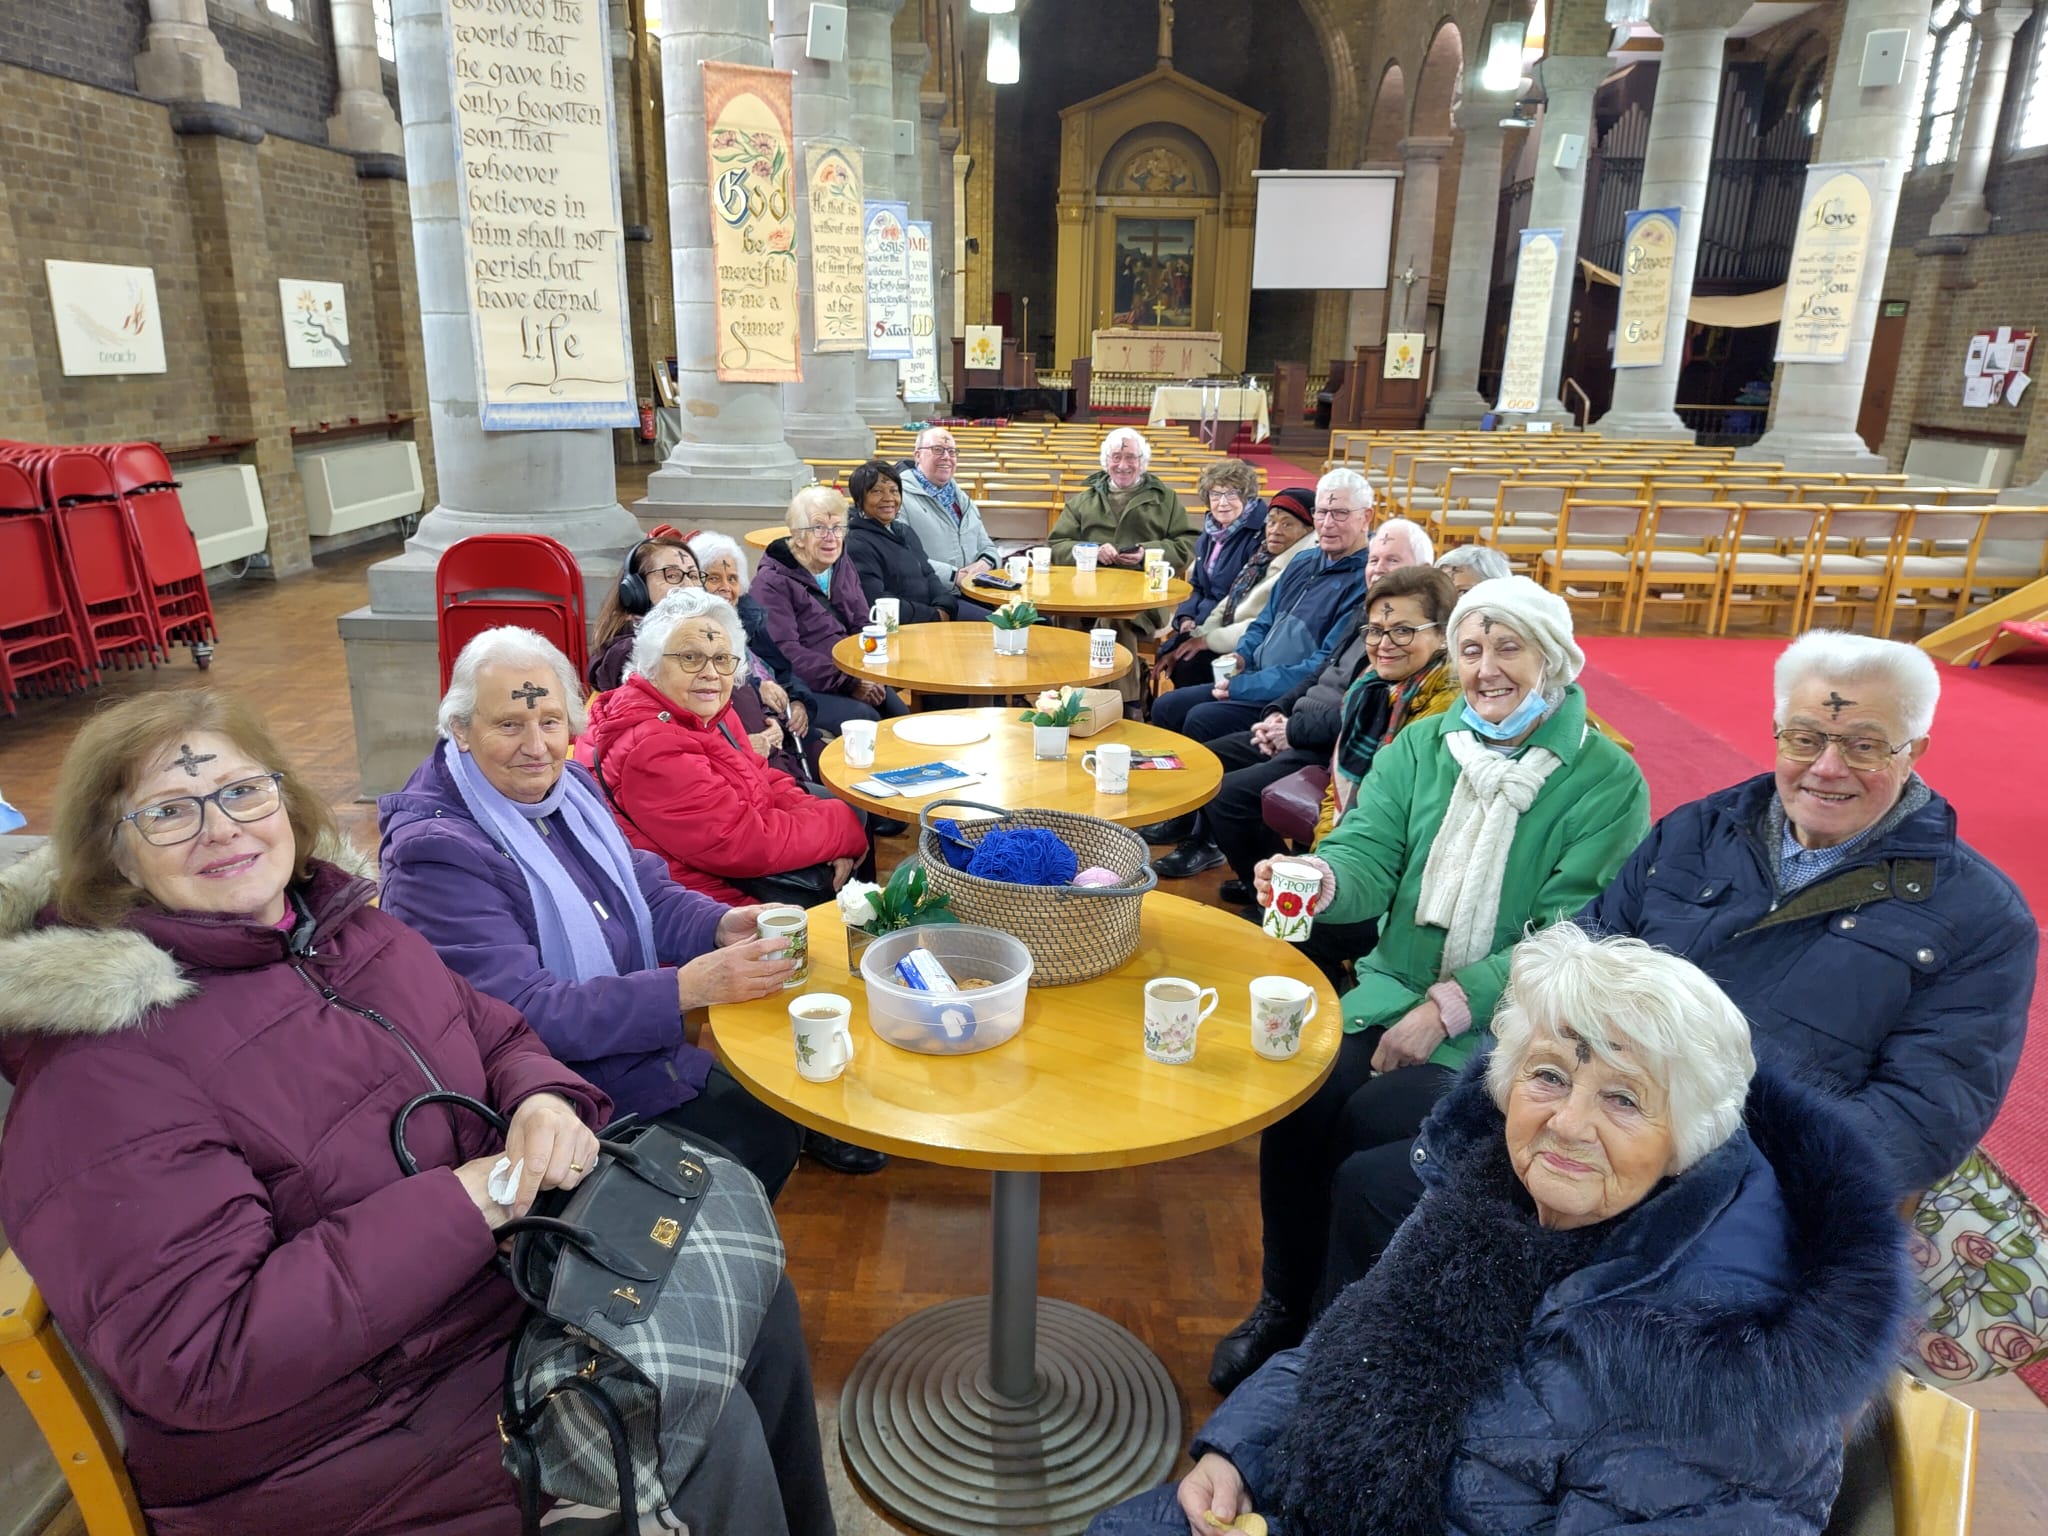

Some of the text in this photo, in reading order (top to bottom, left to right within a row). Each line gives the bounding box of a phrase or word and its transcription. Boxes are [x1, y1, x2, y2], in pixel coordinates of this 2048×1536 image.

[455, 22, 577, 56] world that
[456, 48, 586, 92] he gave his
[458, 90, 602, 126] only begotten
[509, 123, 567, 153] that
[466, 153, 560, 185] whoever
[469, 186, 586, 218] believes in
[714, 168, 790, 229] God
[813, 191, 857, 216] He that is
[1807, 199, 1857, 232] Love
[471, 216, 612, 250] him shall not
[743, 225, 764, 254] be
[549, 252, 594, 281] but
[719, 256, 787, 288] merciful
[815, 259, 826, 273] let
[829, 260, 845, 274] him
[477, 284, 530, 310] have
[740, 294, 765, 308] me
[769, 296, 781, 310] a
[827, 300, 837, 312] at
[1797, 293, 1840, 320] Love
[874, 320, 911, 338] Satan
[1624, 320, 1661, 343] God
